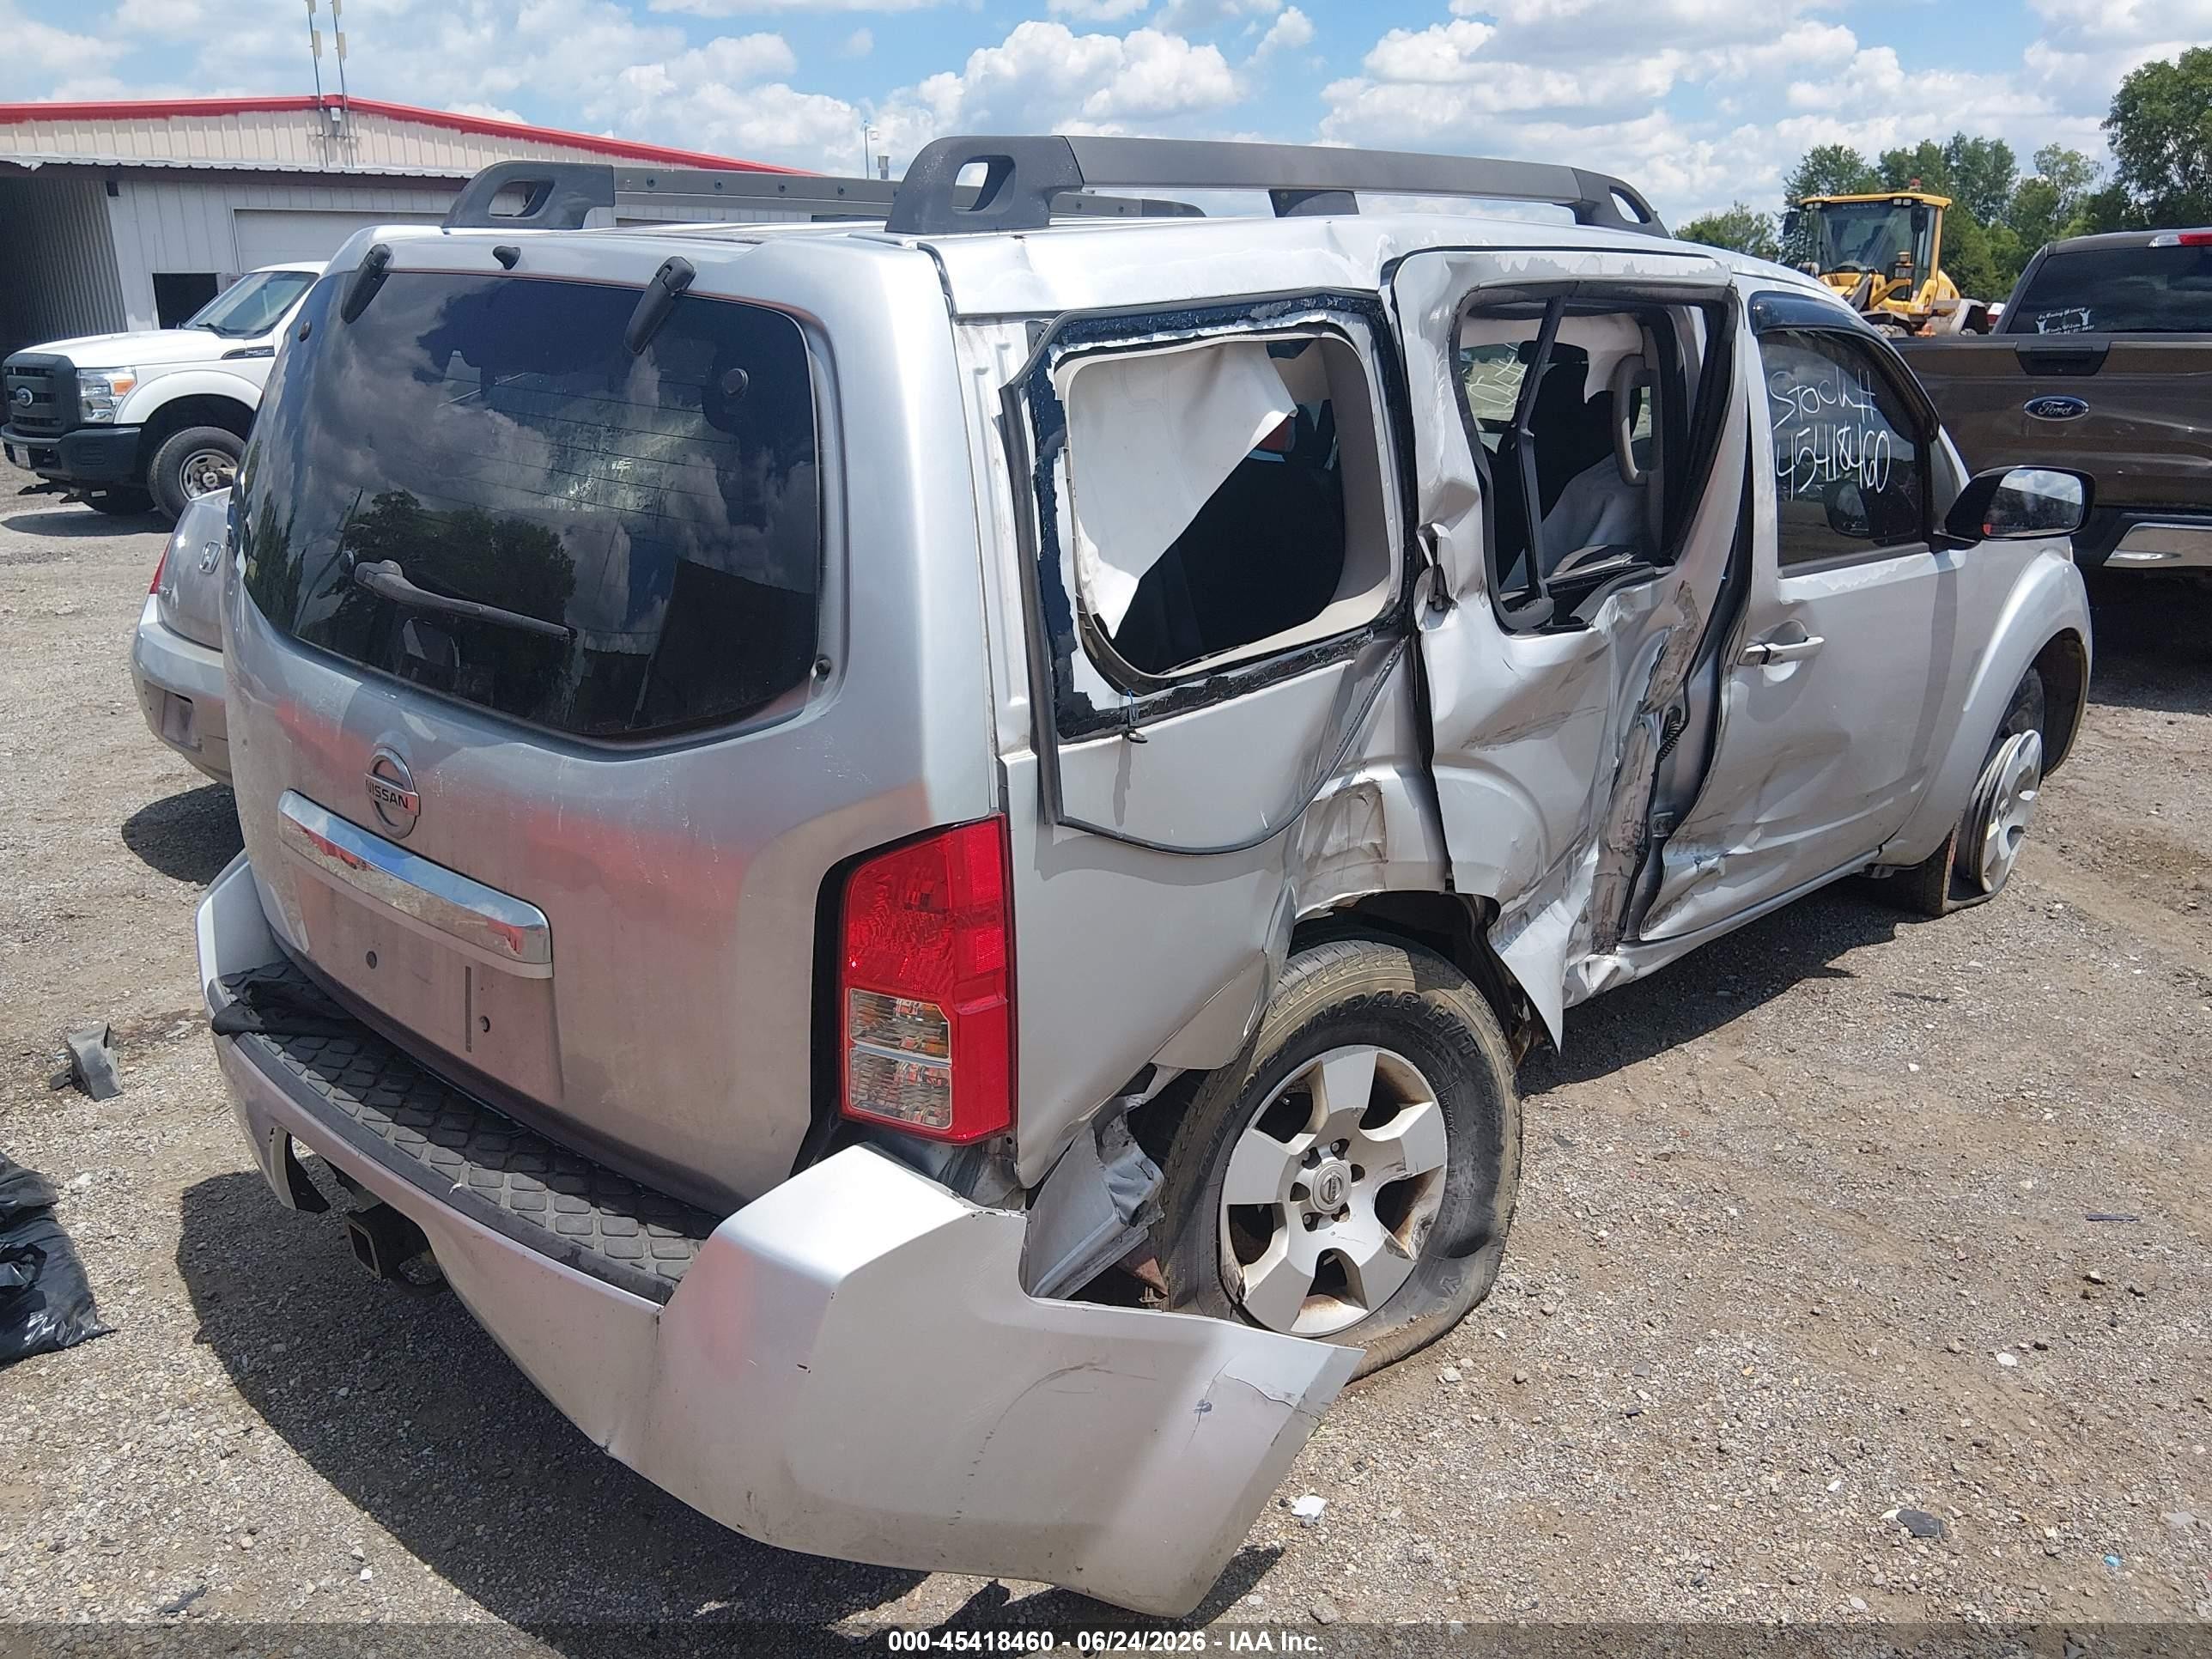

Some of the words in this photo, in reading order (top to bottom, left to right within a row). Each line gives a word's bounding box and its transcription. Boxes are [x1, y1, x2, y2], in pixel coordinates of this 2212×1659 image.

[2038, 401, 2074, 416] Ford
[1777, 420, 1890, 501] 45418460
[365, 779, 410, 810] NISSAN
